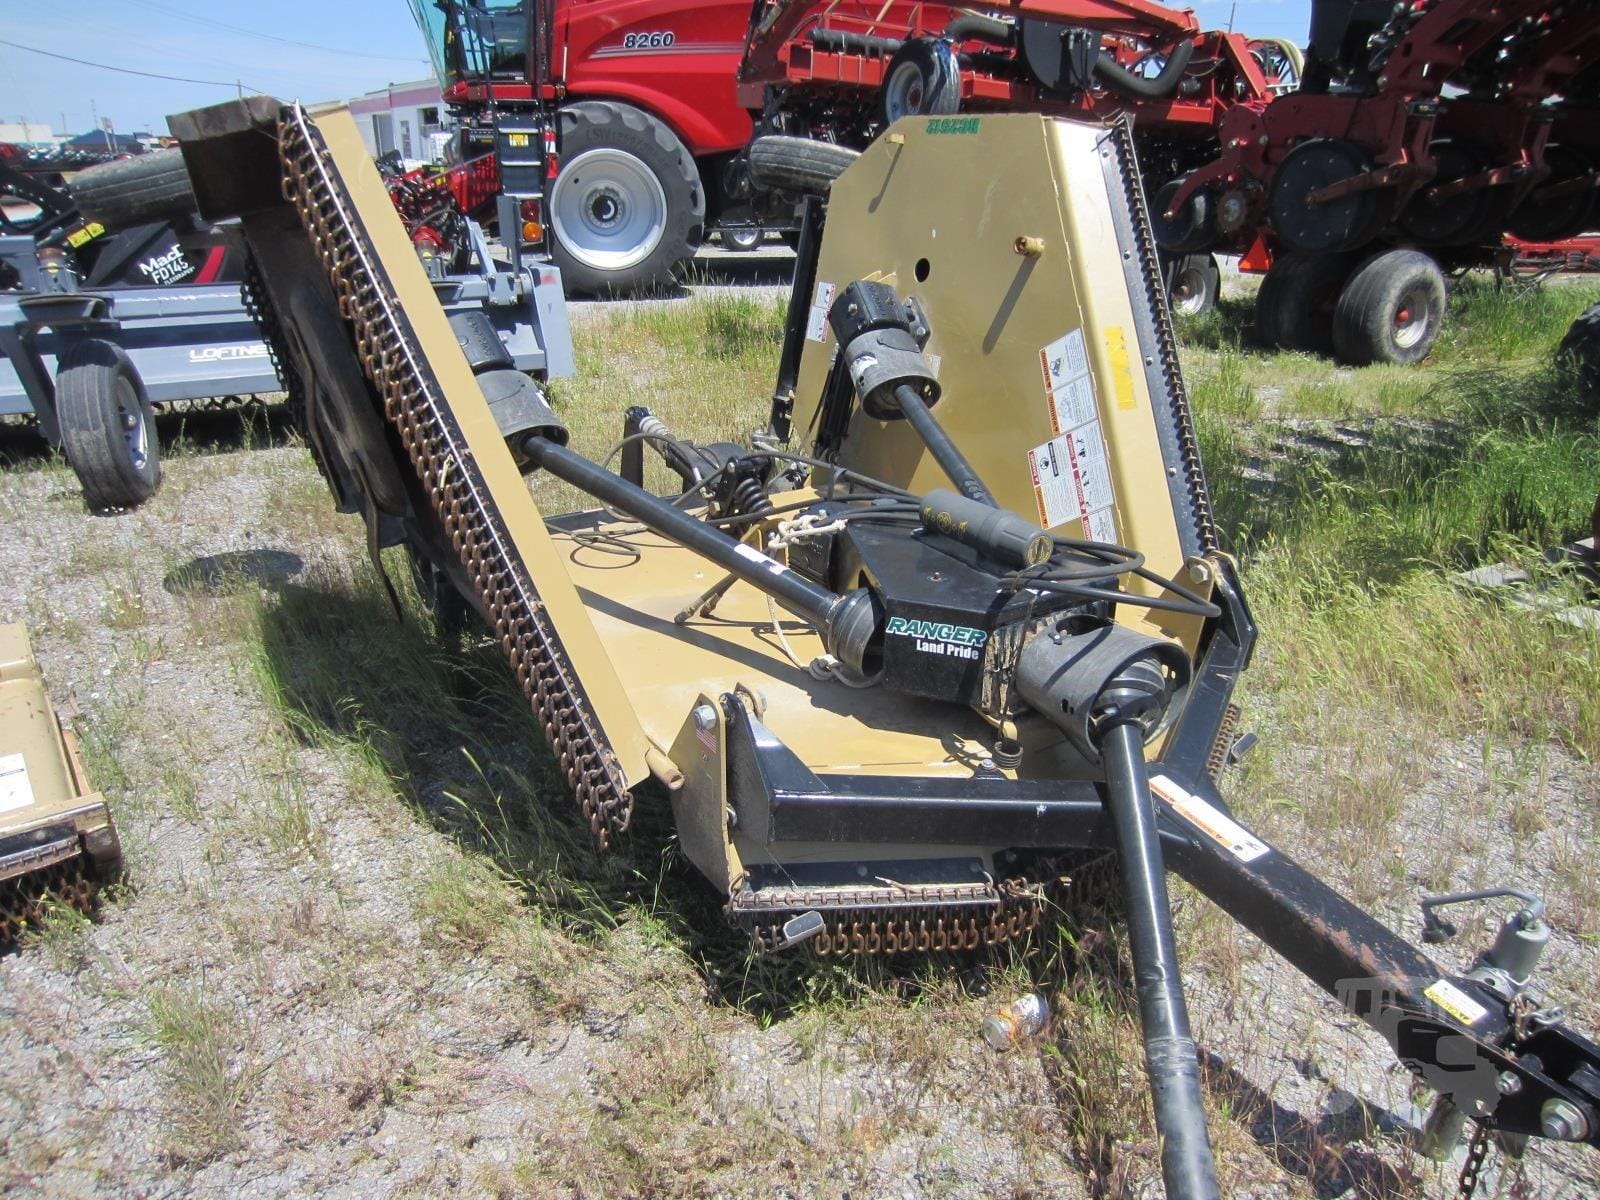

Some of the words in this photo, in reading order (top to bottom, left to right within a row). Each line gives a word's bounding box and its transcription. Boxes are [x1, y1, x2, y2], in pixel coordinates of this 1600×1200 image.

[624, 31, 675, 49] 8260
[151, 257, 189, 285] FD145
[885, 616, 988, 648] RANGER
[916, 639, 945, 655] Land
[946, 643, 980, 660] Pride
